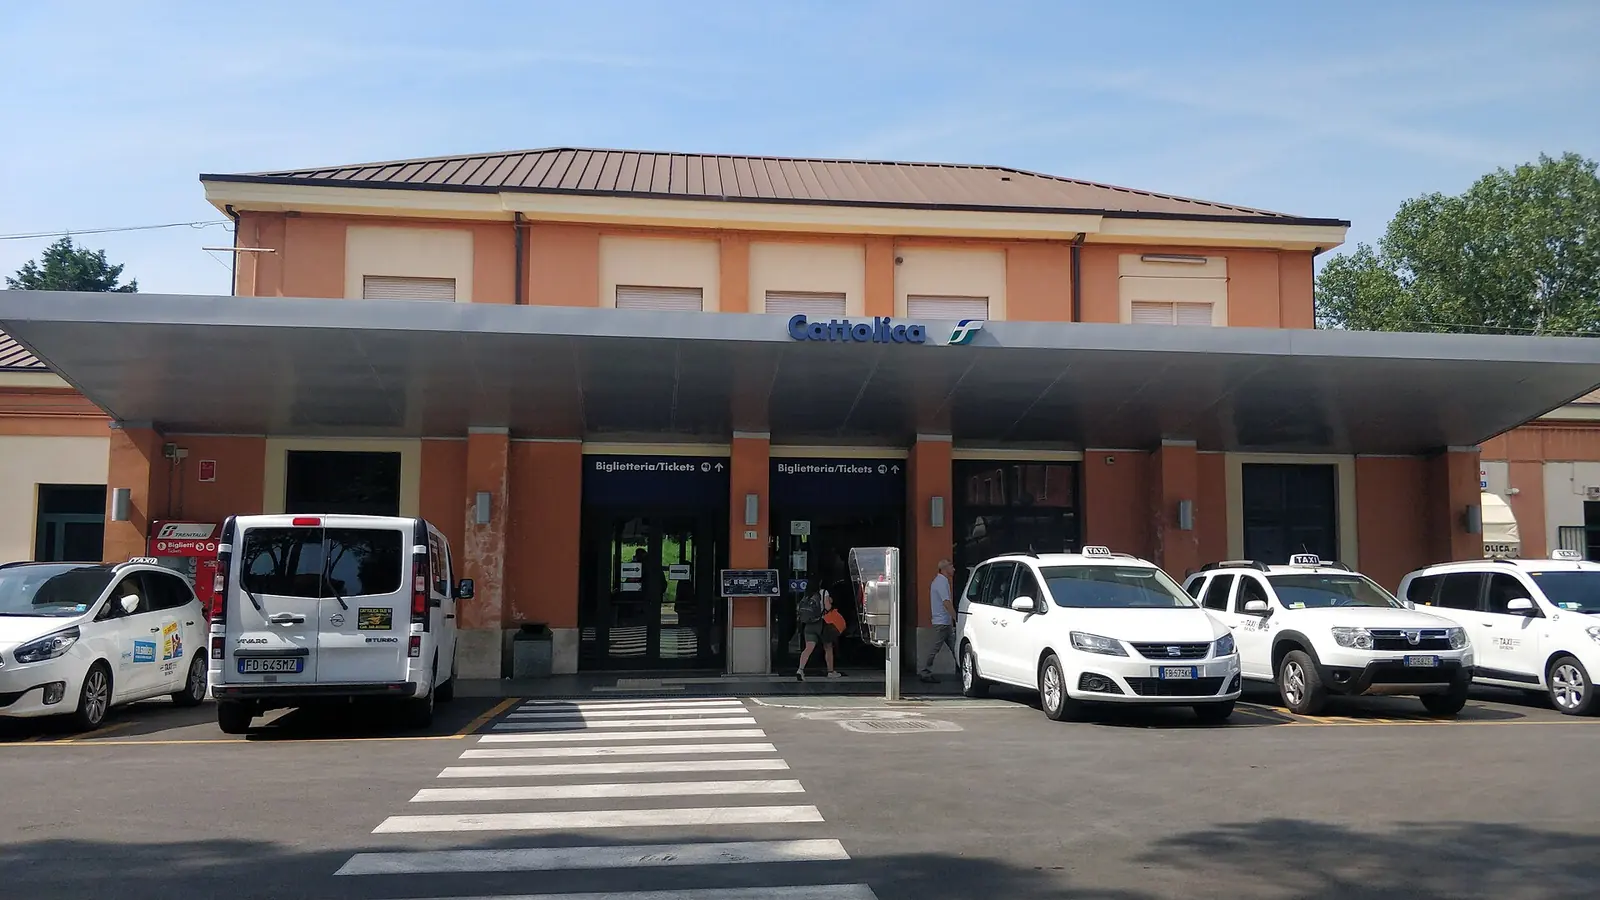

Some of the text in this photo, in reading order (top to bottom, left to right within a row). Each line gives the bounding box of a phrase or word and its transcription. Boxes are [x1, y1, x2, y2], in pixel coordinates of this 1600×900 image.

[788, 314, 926, 344] Cattolica
[595, 461, 695, 473] Biglietteria/Tickets
[777, 463, 873, 475] Biglietteria/Tickets
[1086, 547, 1110, 555] TAXI
[1484, 545, 1517, 553] OLICA.IT
[246, 659, 296, 671] FD 643MZ
